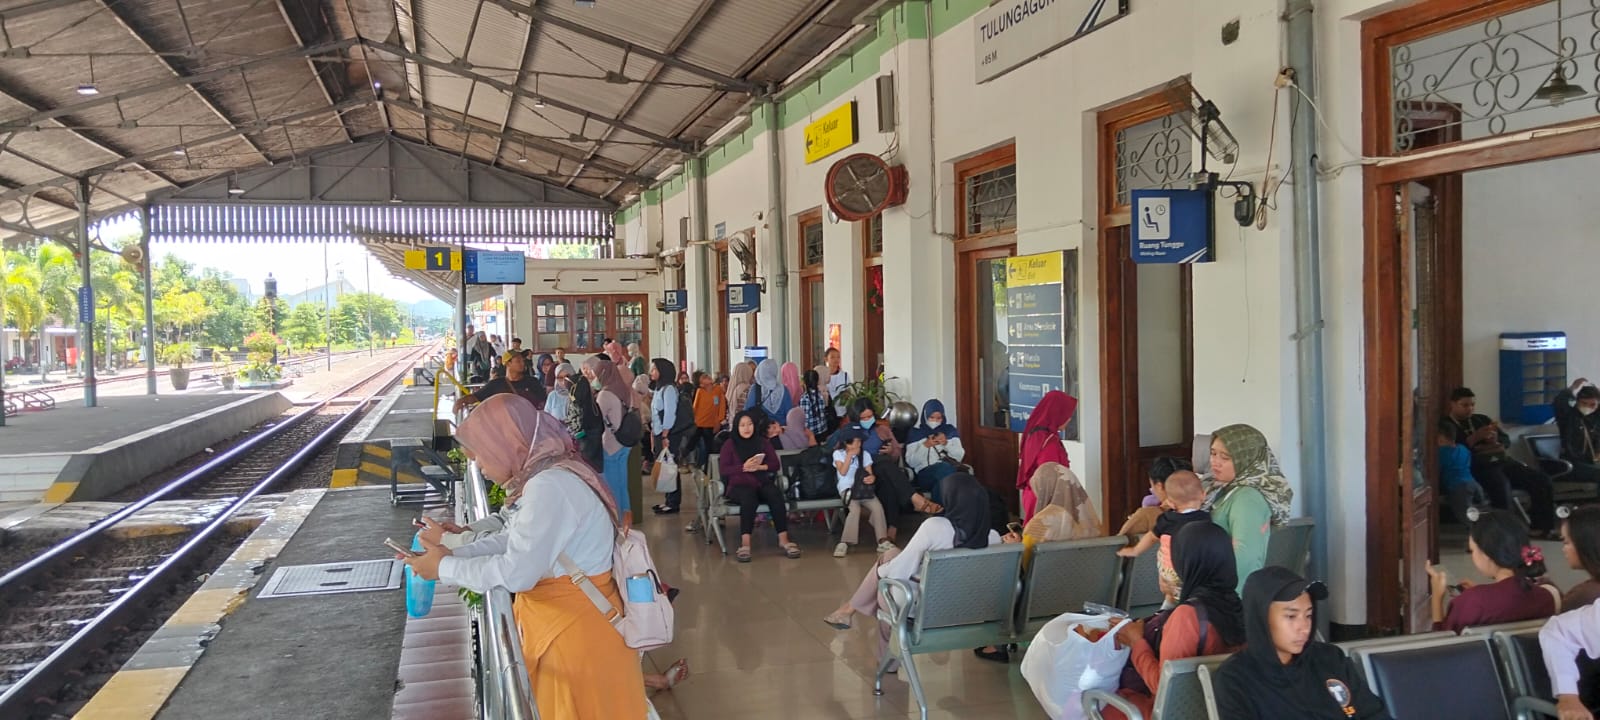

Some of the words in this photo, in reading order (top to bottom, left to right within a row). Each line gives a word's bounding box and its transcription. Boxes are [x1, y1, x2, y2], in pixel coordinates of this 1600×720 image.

[822, 119, 839, 134] Keluar
[434, 251, 443, 267] 1
[1028, 258, 1047, 269] Keluar
